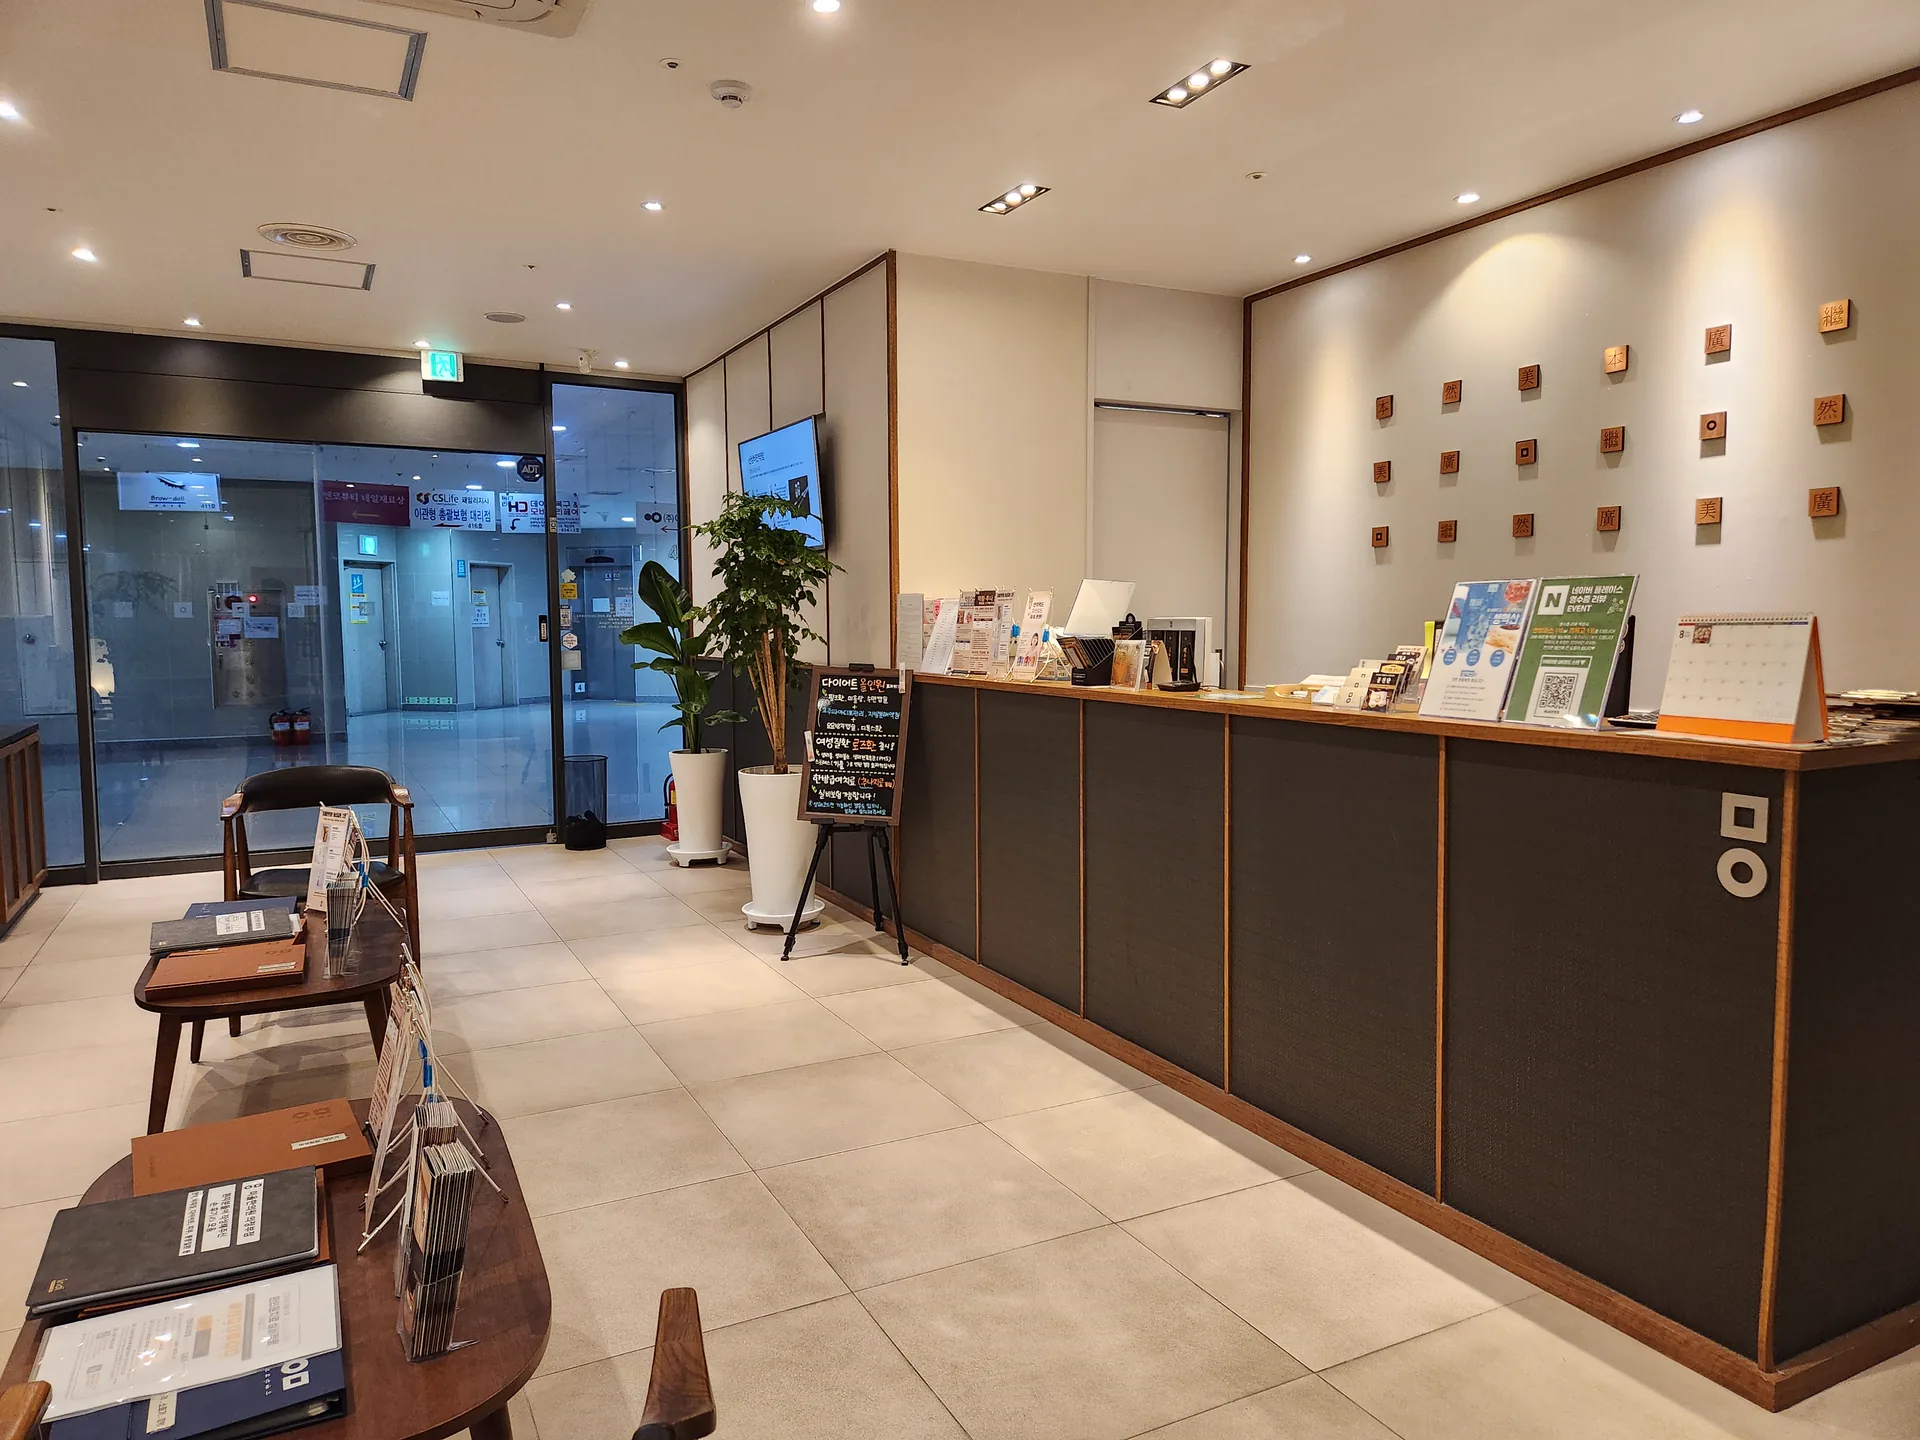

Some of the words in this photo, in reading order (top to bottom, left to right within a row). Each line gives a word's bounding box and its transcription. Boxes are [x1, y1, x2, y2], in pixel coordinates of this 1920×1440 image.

[521, 464, 540, 474] ADT
[432, 493, 459, 503] CSLife
[414, 507, 437, 521] 이관형
[438, 508, 468, 522] 총괄보험
[470, 510, 491, 523] 대리점
[1571, 586, 1593, 594] 네이버
[1594, 585, 1624, 594] 플레이스
[1544, 592, 1562, 608] N
[1569, 595, 1591, 604] 영수증
[1591, 595, 1607, 604] 리뷰
[1566, 604, 1592, 613] EVENT
[821, 677, 858, 688] 다이어트
[859, 678, 886, 693] 올인원
[815, 737, 851, 749] 여성질환
[852, 738, 877, 752] 로즈환
[812, 773, 857, 787] 한방급여치료
[818, 789, 843, 800] 실비보험
[842, 790, 876, 801] 가능합니다!
[243, 1216, 256, 1238] 의정부점
